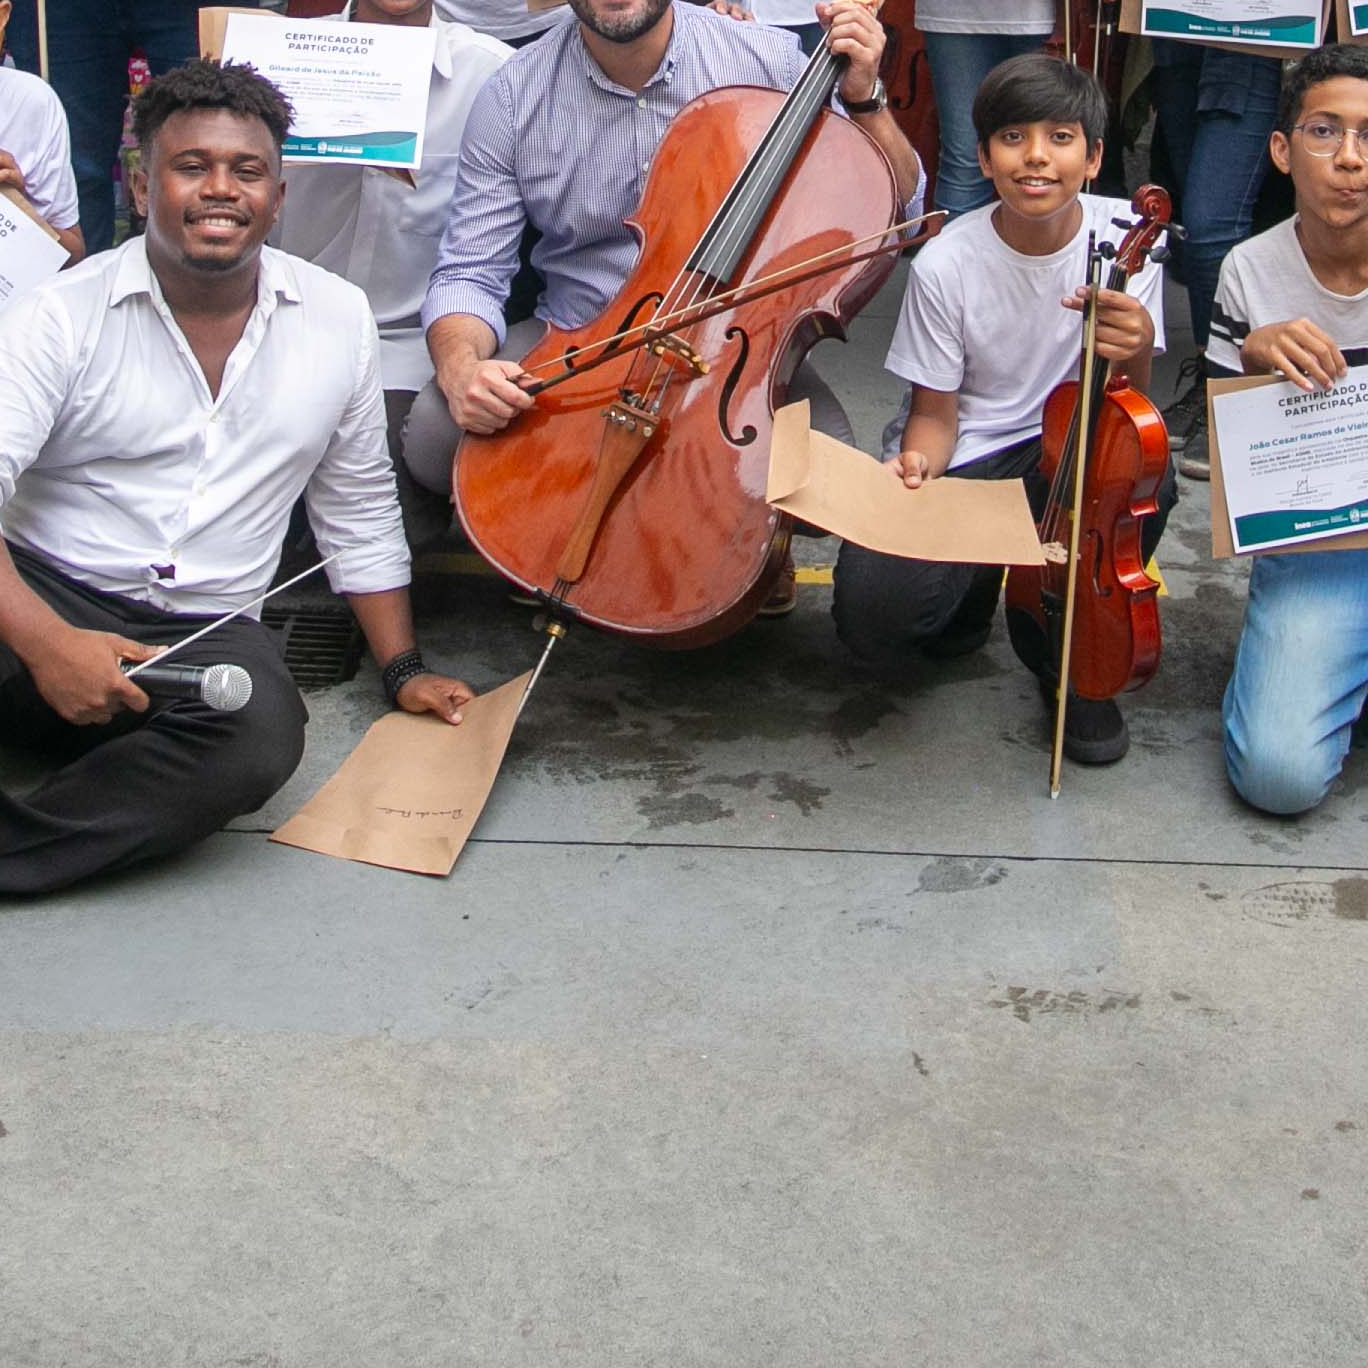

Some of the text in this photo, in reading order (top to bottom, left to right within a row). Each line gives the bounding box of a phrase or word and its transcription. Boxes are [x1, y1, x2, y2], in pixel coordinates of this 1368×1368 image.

[285, 32, 358, 44] CERTIFICADO
[288, 43, 369, 55] PARTICIPAÇÃO
[4, 219, 17, 233] DE
[1278, 385, 1356, 407] CERTIFICADO
[1249, 441, 1270, 451] João
[1272, 436, 1299, 446] Cesar
[1300, 431, 1332, 440] Ramos
[1334, 426, 1345, 434] de
